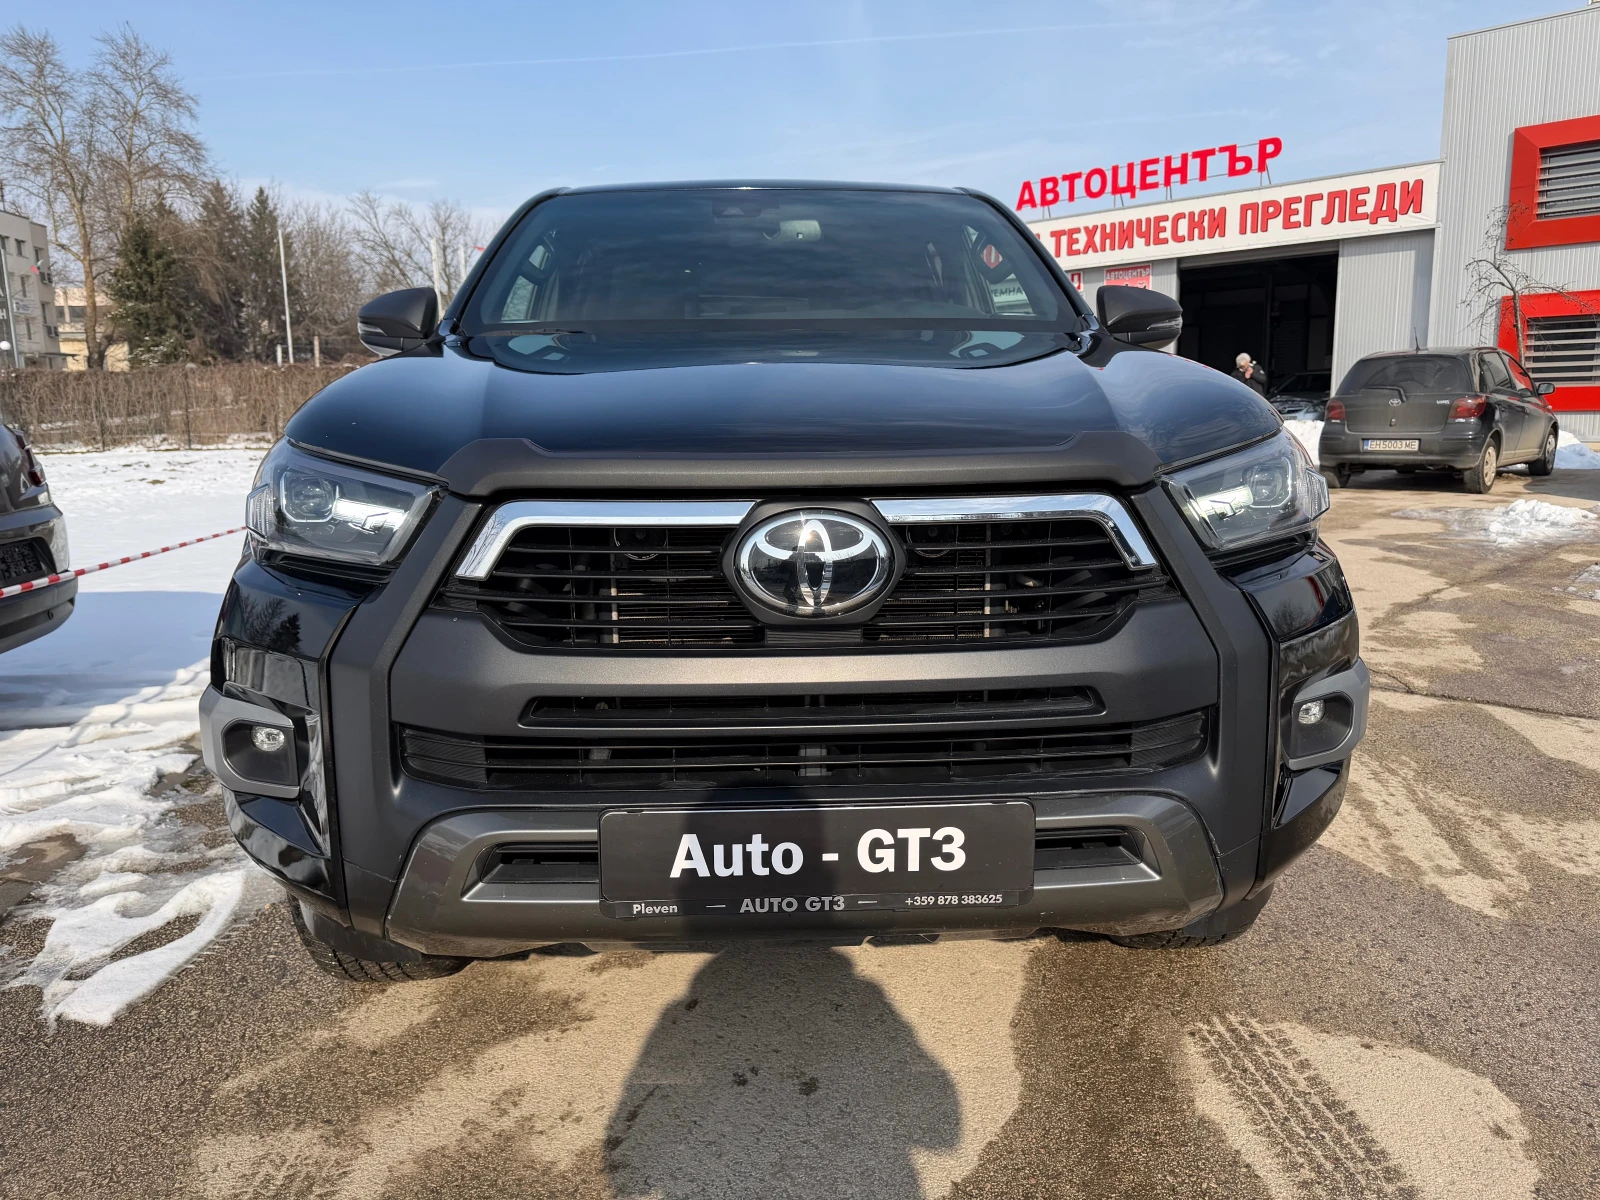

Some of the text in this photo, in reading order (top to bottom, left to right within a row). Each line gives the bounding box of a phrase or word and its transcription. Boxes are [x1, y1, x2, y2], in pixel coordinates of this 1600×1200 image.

[1016, 137, 1283, 211] АВТОЦЕНТЪР
[1050, 178, 1424, 258] ТЕХНИЧЕСКИ ПРЕГЛЕДИ
[1105, 267, 1150, 281] АВТОЦЕНТЪР
[669, 833, 804, 878] Auto
[857, 826, 966, 873] GT3
[739, 895, 845, 913] AUTO GT3
[905, 893, 1003, 906] +359 878 383625
[632, 903, 678, 915] Pleven
